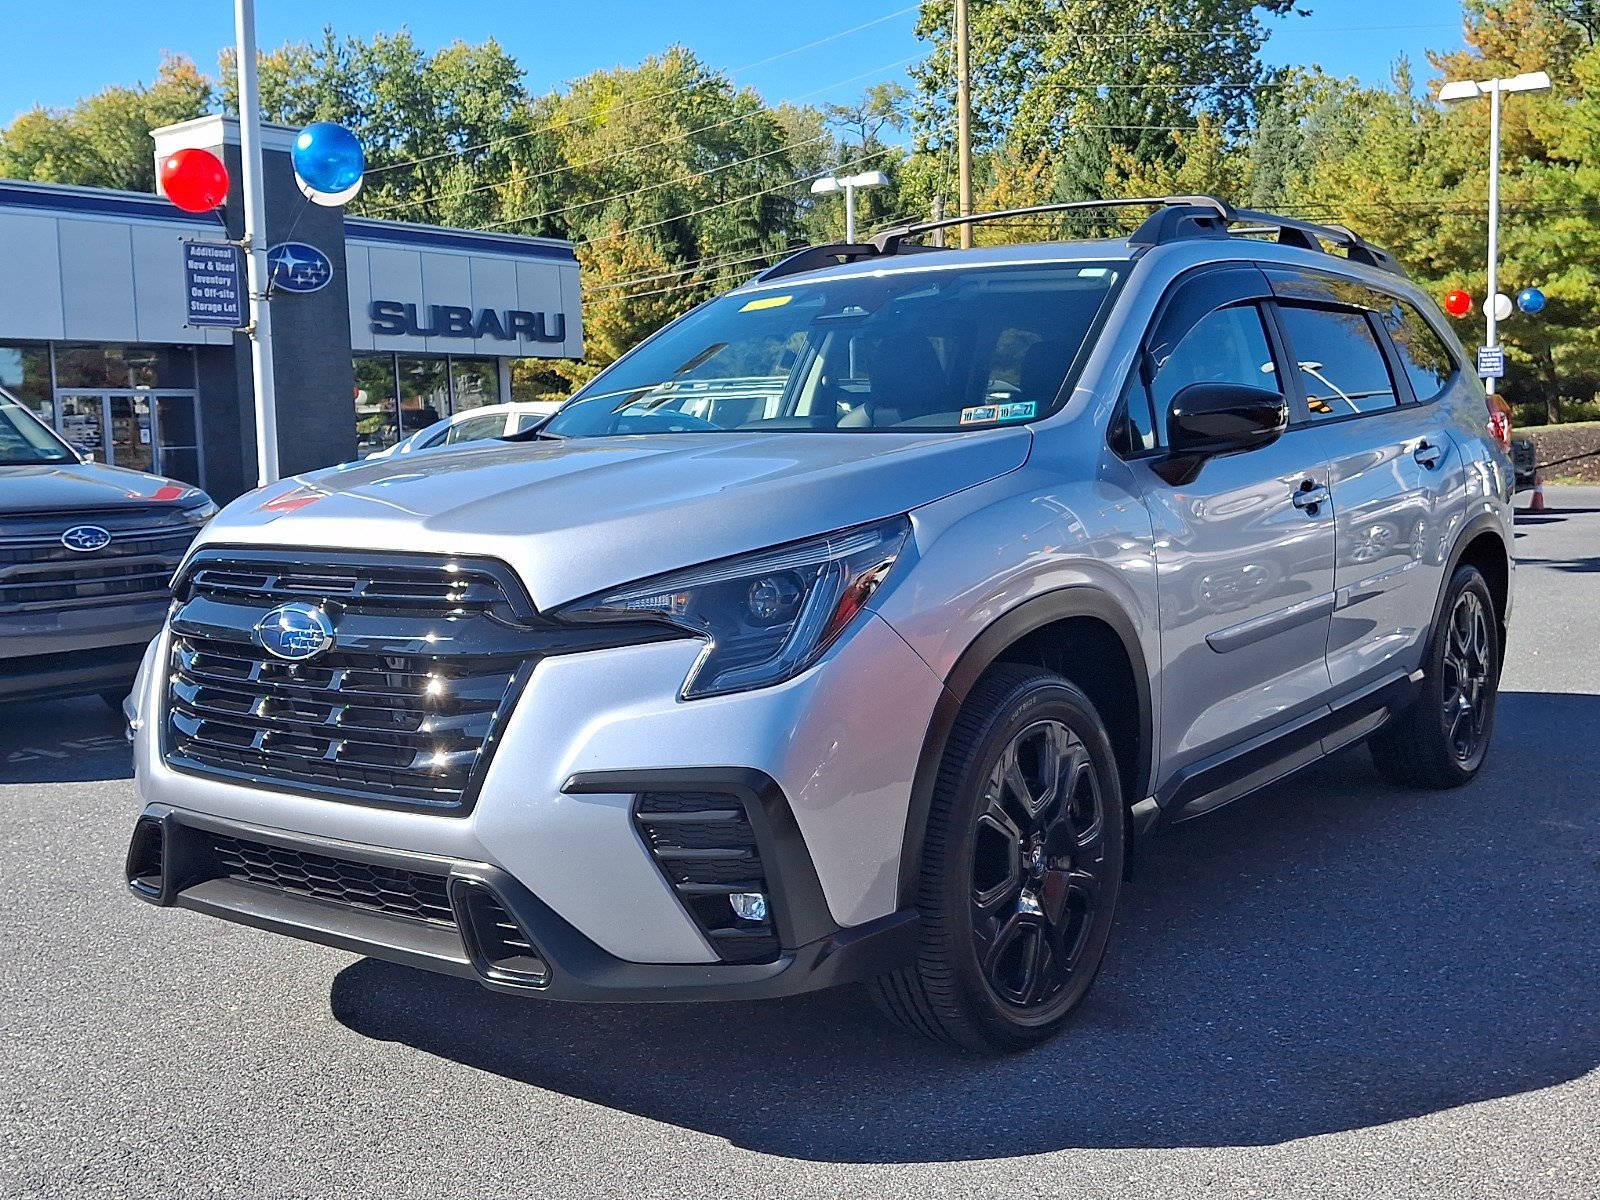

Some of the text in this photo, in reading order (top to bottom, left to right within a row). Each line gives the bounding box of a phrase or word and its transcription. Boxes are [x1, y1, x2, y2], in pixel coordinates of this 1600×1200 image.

[190, 246, 231, 258] Additional
[188, 260, 235, 272] New & Used
[193, 274, 231, 286] Inventory
[191, 287, 234, 298] On Off-site
[190, 301, 237, 313] Storage Lot
[369, 300, 566, 343] SUBARU
[1011, 696, 1037, 722] OUTSIDE
